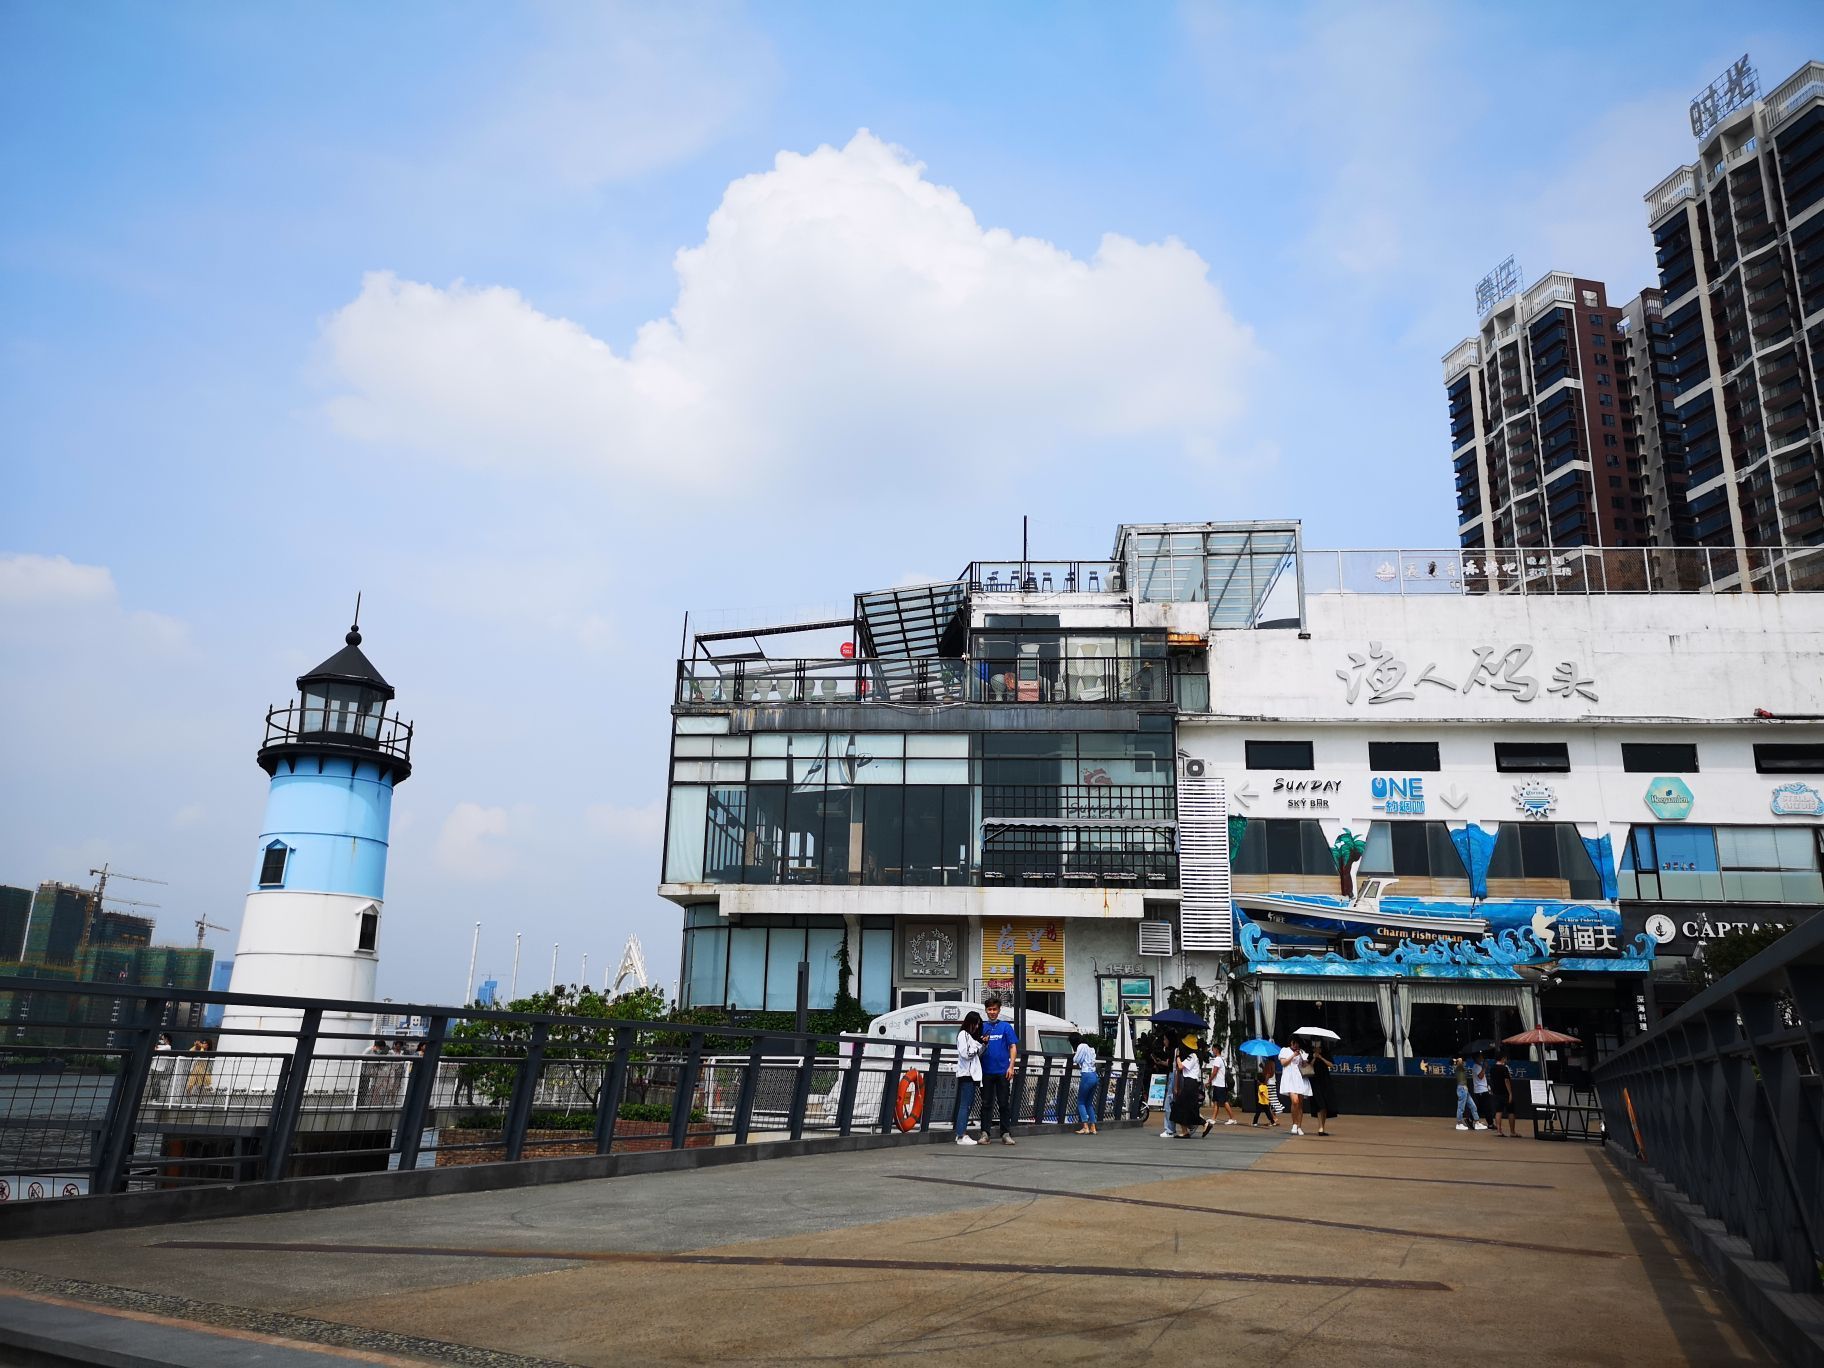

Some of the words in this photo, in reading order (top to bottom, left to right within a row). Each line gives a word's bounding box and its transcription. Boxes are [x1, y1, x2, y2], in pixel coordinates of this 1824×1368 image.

[1690, 53, 1756, 137] 时光
[1336, 640, 1598, 704] 渔人码头
[1273, 778, 1342, 792] SUNDAY
[1372, 777, 1424, 799] ONE
[1288, 799, 1306, 808] SKY
[1310, 799, 1329, 808] BAR
[1377, 927, 1409, 938] Charm
[1573, 924, 1618, 950] 渔夫
